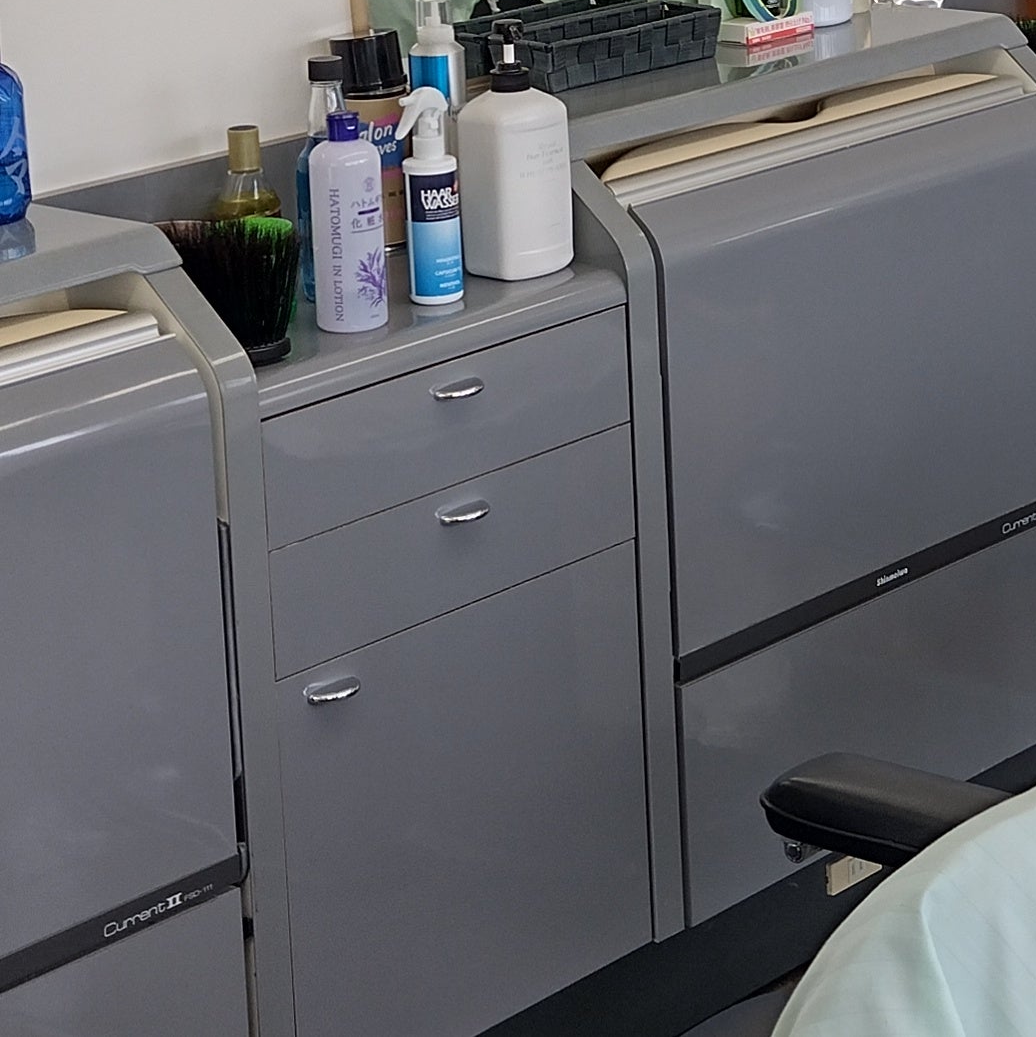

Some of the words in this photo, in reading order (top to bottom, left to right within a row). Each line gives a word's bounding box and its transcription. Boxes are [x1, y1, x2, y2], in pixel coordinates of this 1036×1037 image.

[328, 188, 343, 260] HATOMUGI
[332, 264, 343, 277] IN
[333, 280, 345, 322] LOTION
